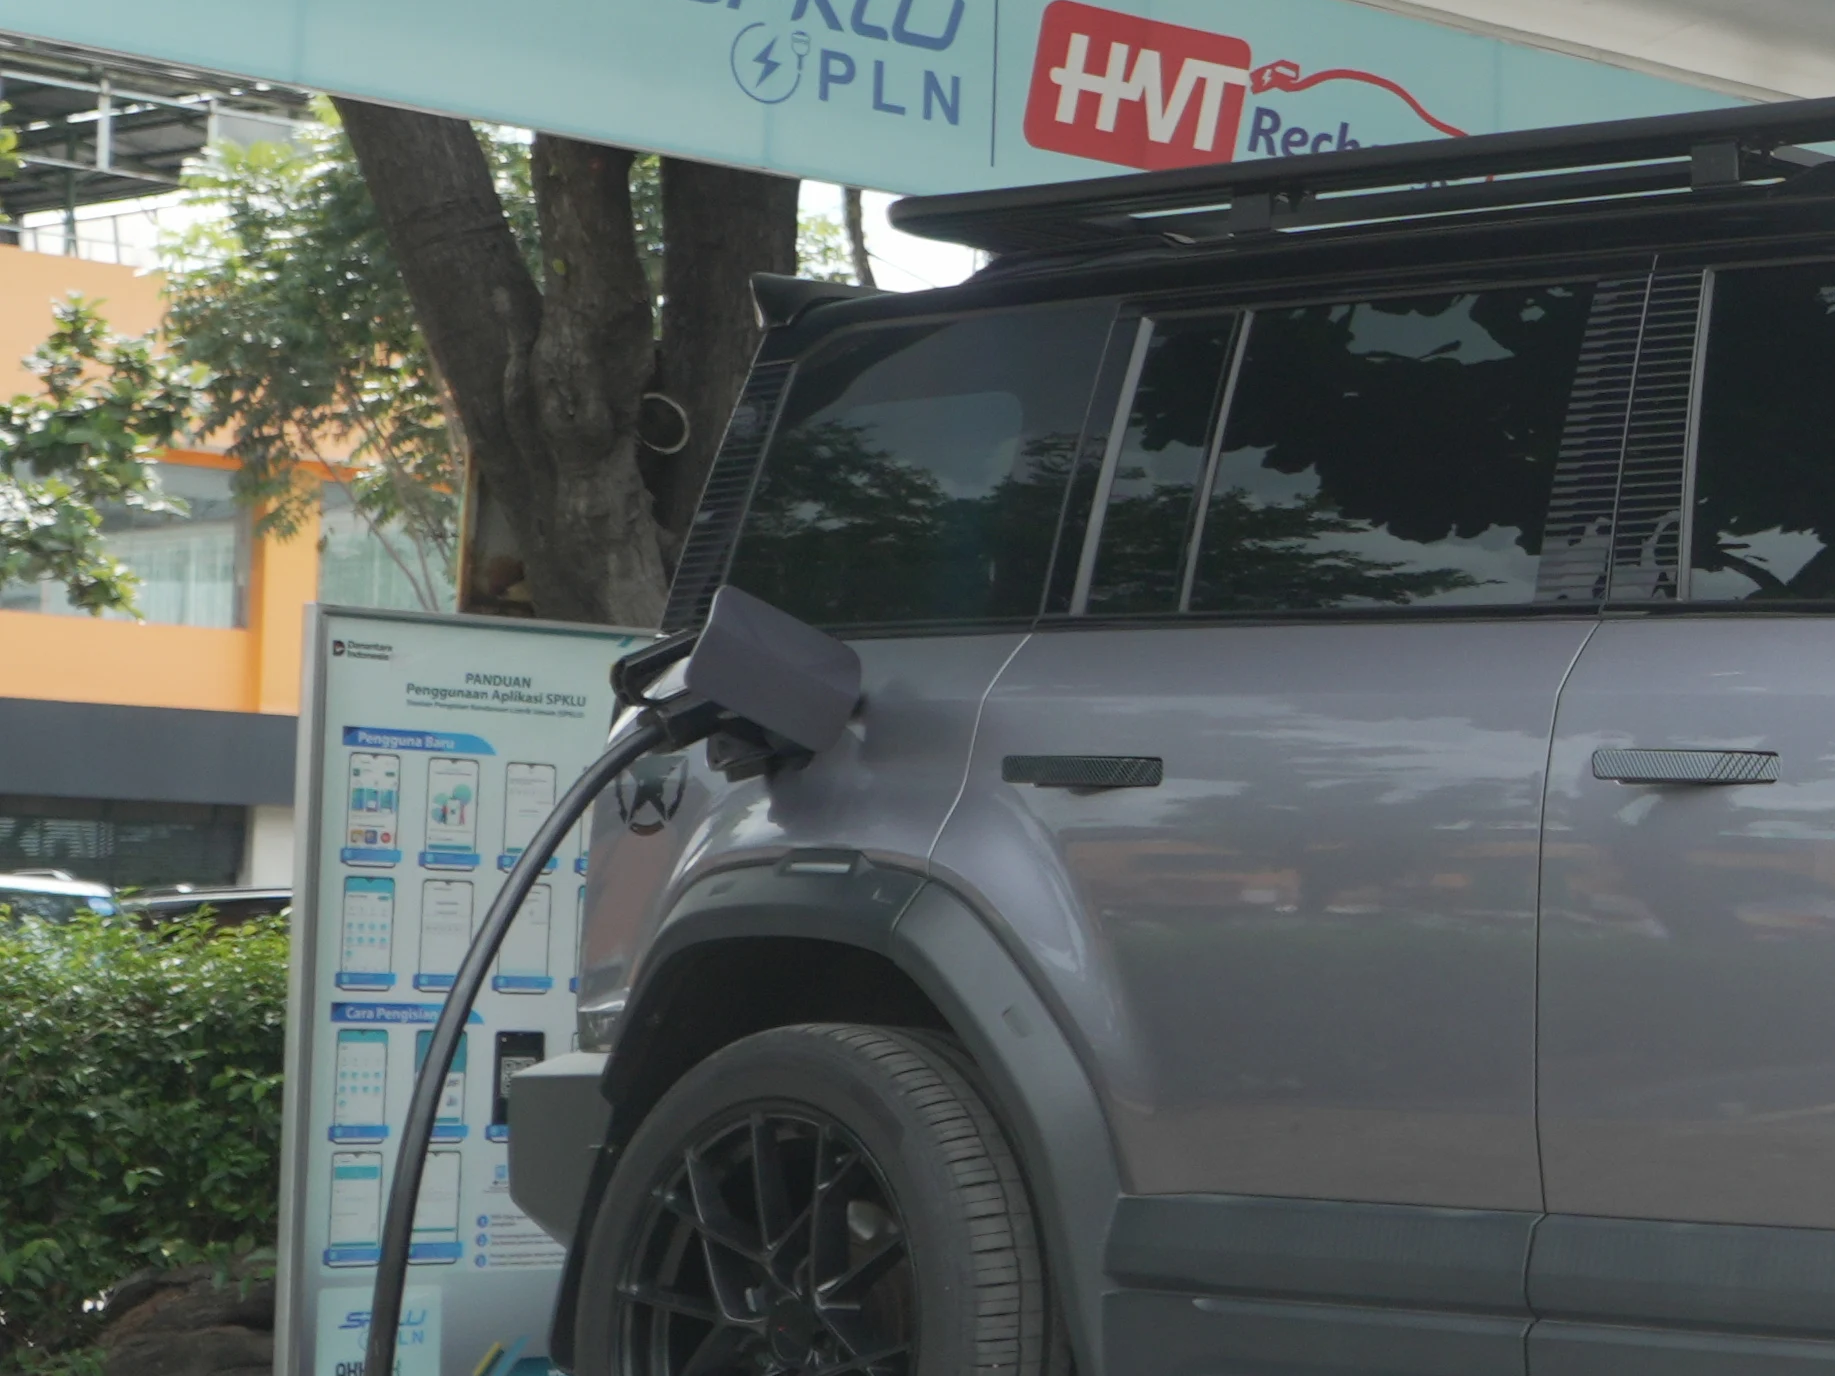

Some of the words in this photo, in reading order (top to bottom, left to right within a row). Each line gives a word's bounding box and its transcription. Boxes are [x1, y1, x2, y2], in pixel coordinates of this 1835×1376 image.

[818, 48, 961, 126] PLN
[1247, 106, 1375, 157] Rech
[464, 672, 532, 689] PANDUAN
[406, 682, 488, 700] Penggunaan
[491, 689, 543, 705] Aplikasi
[546, 693, 587, 708] SPKLU
[358, 731, 423, 749] Pengguna
[425, 735, 455, 749] Baru
[345, 1006, 374, 1020] Cara
